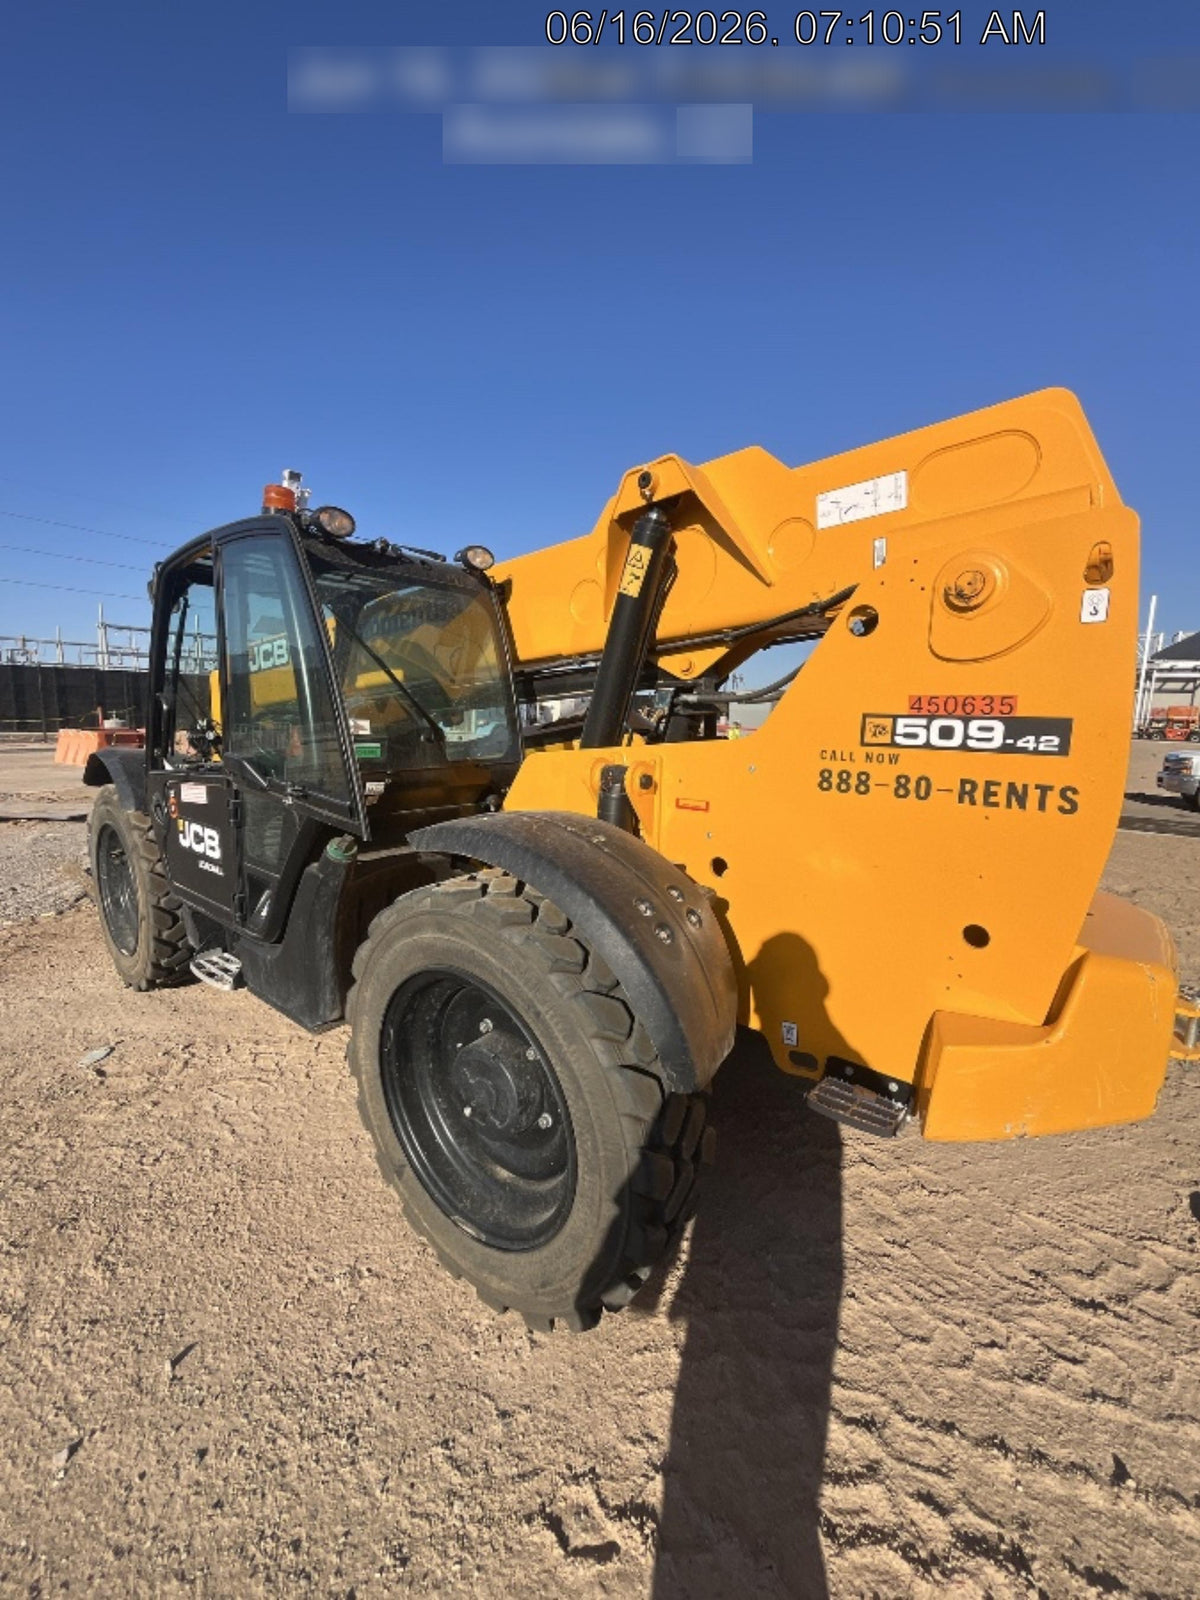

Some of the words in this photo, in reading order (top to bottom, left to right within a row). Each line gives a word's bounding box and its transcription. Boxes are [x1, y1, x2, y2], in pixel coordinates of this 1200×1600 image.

[249, 638, 289, 672] JCB
[909, 696, 1015, 715] 450635
[820, 750, 856, 763] CALL
[865, 752, 901, 765] NOW
[178, 820, 222, 859] JCB
